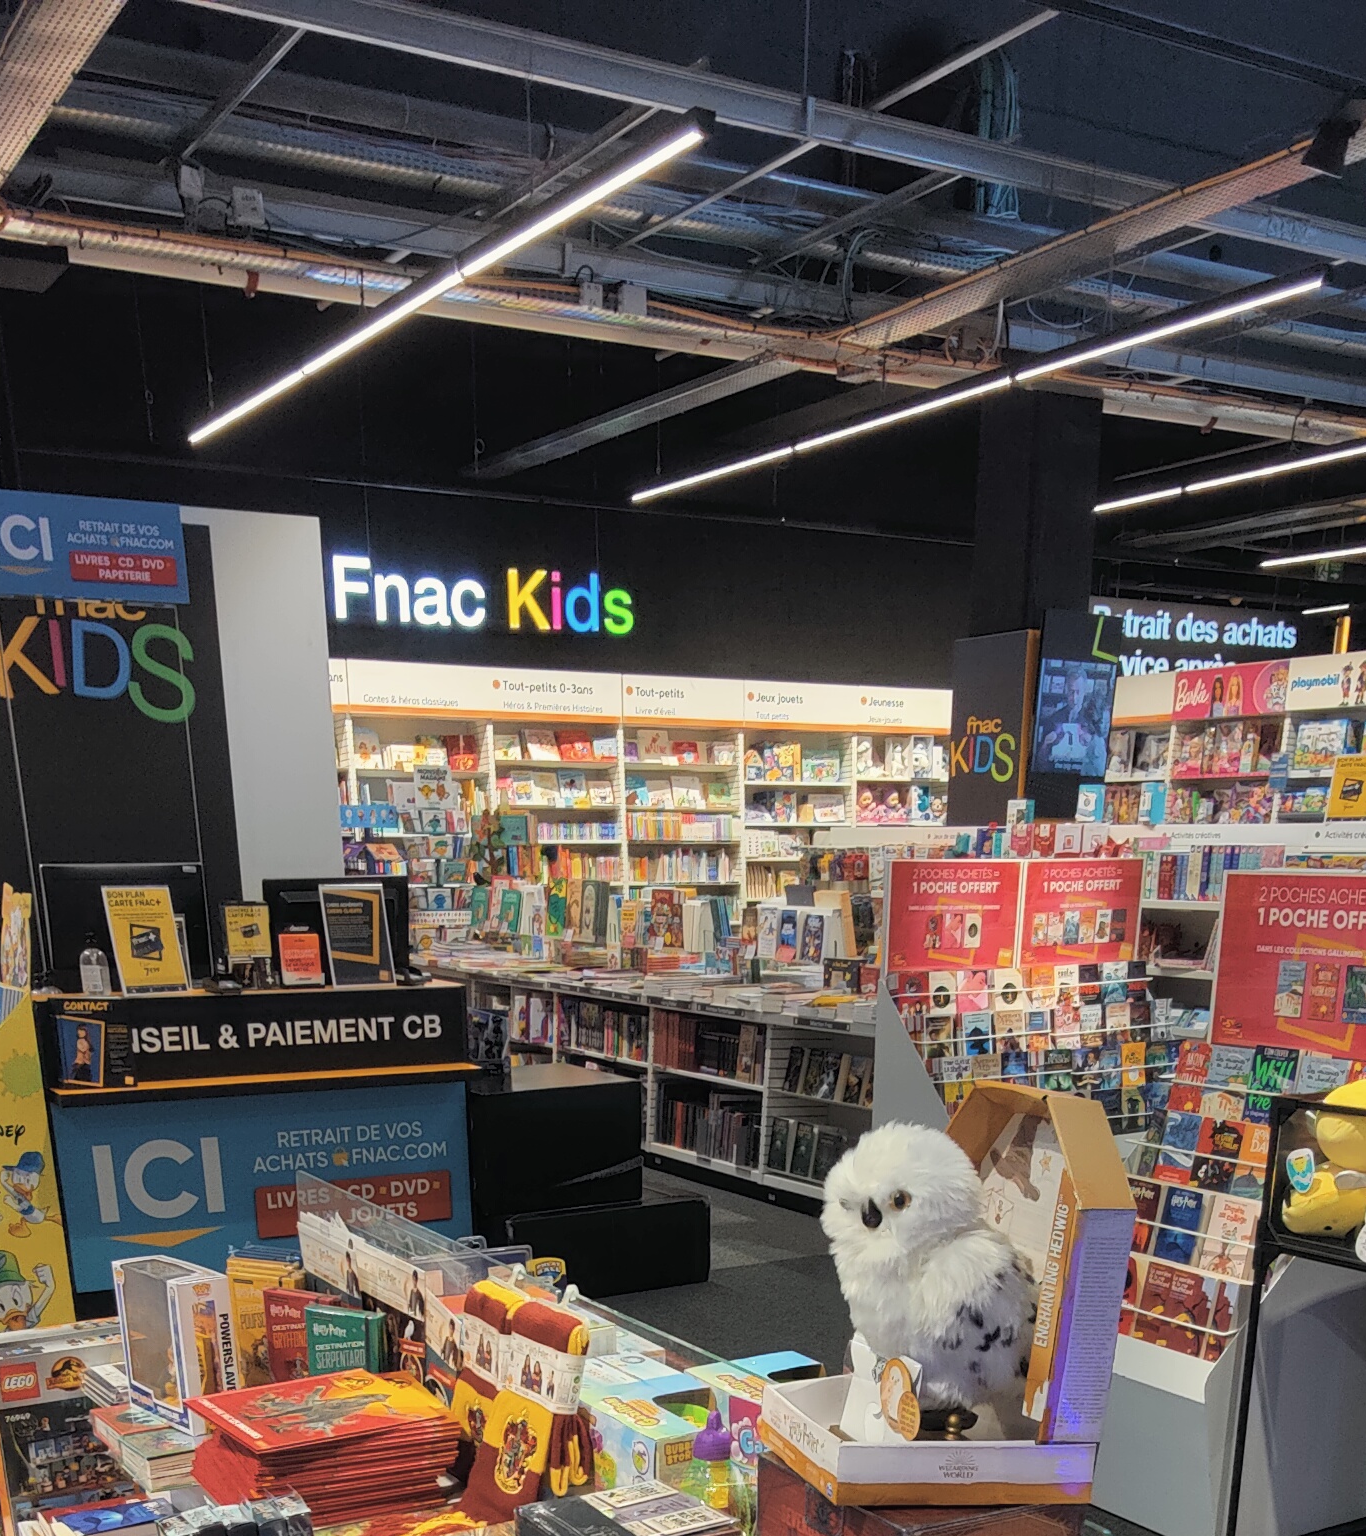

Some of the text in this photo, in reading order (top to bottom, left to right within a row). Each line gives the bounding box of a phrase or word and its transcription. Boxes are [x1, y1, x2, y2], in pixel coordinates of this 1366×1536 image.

[78, 520, 160, 536] RETRAIT DE VOS
[67, 533, 175, 550] ACHATS FNAC.COM
[74, 554, 165, 570] LIVRES CD DVD
[98, 568, 151, 582] PAPETERIE
[332, 554, 634, 634] Fnac Kids
[1176, 612, 1218, 645] des
[1223, 616, 1297, 650] achats
[502, 680, 594, 696] Tout-petits 0-3ans
[1290, 675, 1340, 692] playmobil
[635, 687, 685, 700] Tout-petits
[755, 692, 804, 705] Jeux jouets
[1176, 679, 1210, 713] Barbie
[868, 697, 904, 709] Jeunesse
[966, 716, 1002, 735] fnac
[951, 733, 1016, 784] KIDS
[1324, 831, 1353, 840] Activités
[912, 867, 992, 879] 2 POCHES ACHETÉS
[1044, 867, 1117, 879] 2 POCHES ACHETÉS
[125, 889, 146, 899] PLAN
[912, 882, 998, 894] 1 POCHE OFFERT
[1043, 879, 1121, 893] 1 POCHE OFFERT
[1259, 886, 1269, 903] 2
[1269, 887, 1325, 905] POCHES
[1258, 909, 1266, 926] 1
[1268, 908, 1328, 929] POCHE
[63, 1001, 109, 1012] CONTACT
[217, 1024, 240, 1050] &
[246, 1016, 395, 1048] PAIEMENT
[402, 1014, 442, 1040] CB
[1187, 1052, 1205, 1066] MON
[276, 1120, 423, 1149] RETRAIT DE VOS
[253, 1141, 447, 1174] ACHATS FNAC.COM
[92, 1136, 227, 1224] ICI
[266, 1178, 431, 1211] LIVRES CD DVD
[1034, 1203, 1071, 1349] ENCHANTING HEDWIG
[315, 1340, 366, 1352] DESTINATION
[315, 1348, 366, 1370] SERPENTARD
[3, 1371, 35, 1392] LEGO
[4, 1411, 31, 1423] 76949
[938, 1463, 980, 1475] WIZARDING
[942, 1470, 974, 1480] WORLD
